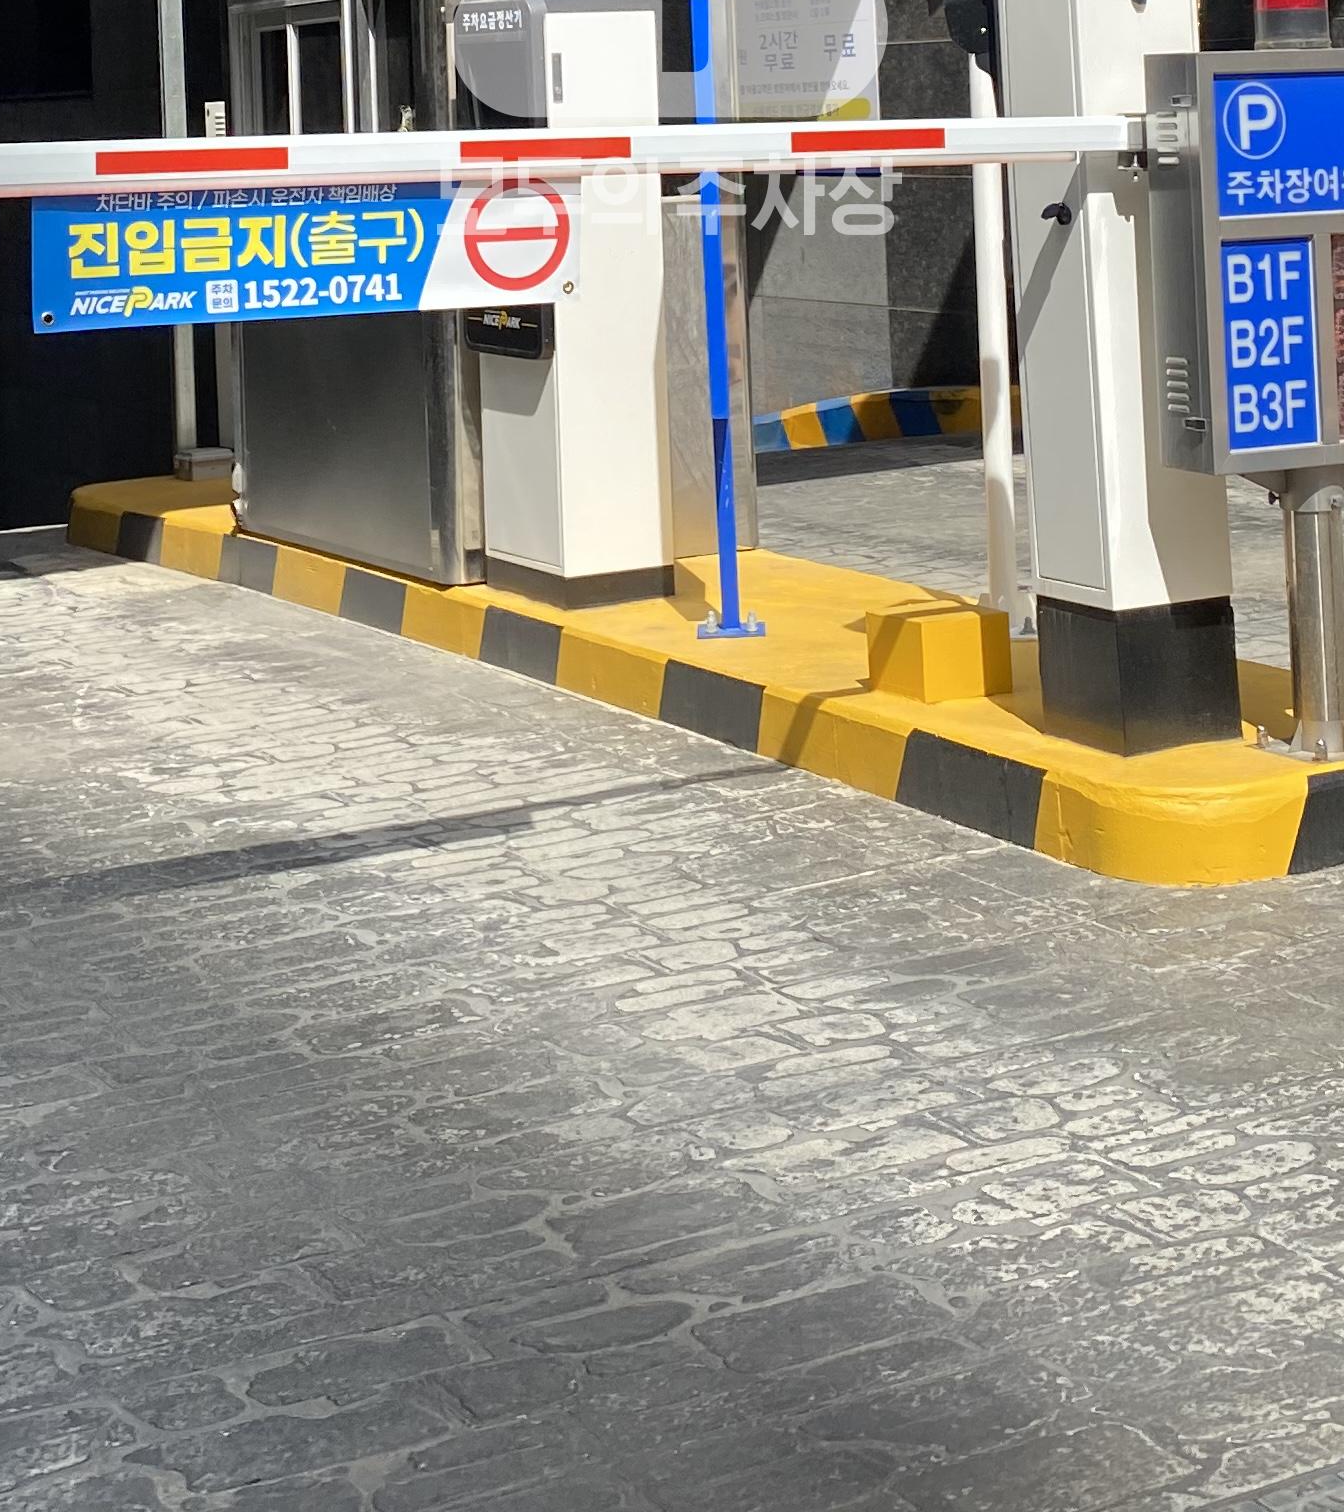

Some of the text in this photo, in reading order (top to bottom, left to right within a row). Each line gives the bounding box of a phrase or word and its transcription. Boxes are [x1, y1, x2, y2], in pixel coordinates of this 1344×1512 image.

[462, 9, 523, 32] 주차요금정산기
[759, 31, 798, 50] 2시간
[824, 33, 856, 62] 무료
[764, 53, 795, 72] 무료
[1237, 93, 1278, 151] P
[96, 193, 152, 213] 차단바
[156, 192, 193, 210] 주의
[213, 191, 267, 209] 파손시
[272, 188, 324, 206] 운전자
[329, 184, 397, 203] 책임배상
[68, 208, 425, 279] 진입금지(출구)
[211, 283, 233, 295] 주차
[244, 273, 402, 309] 1522-0741
[1226, 251, 1302, 304] B1F
[212, 297, 234, 309] 문의
[1230, 315, 1304, 369] B2F
[1232, 379, 1307, 434] B3F
